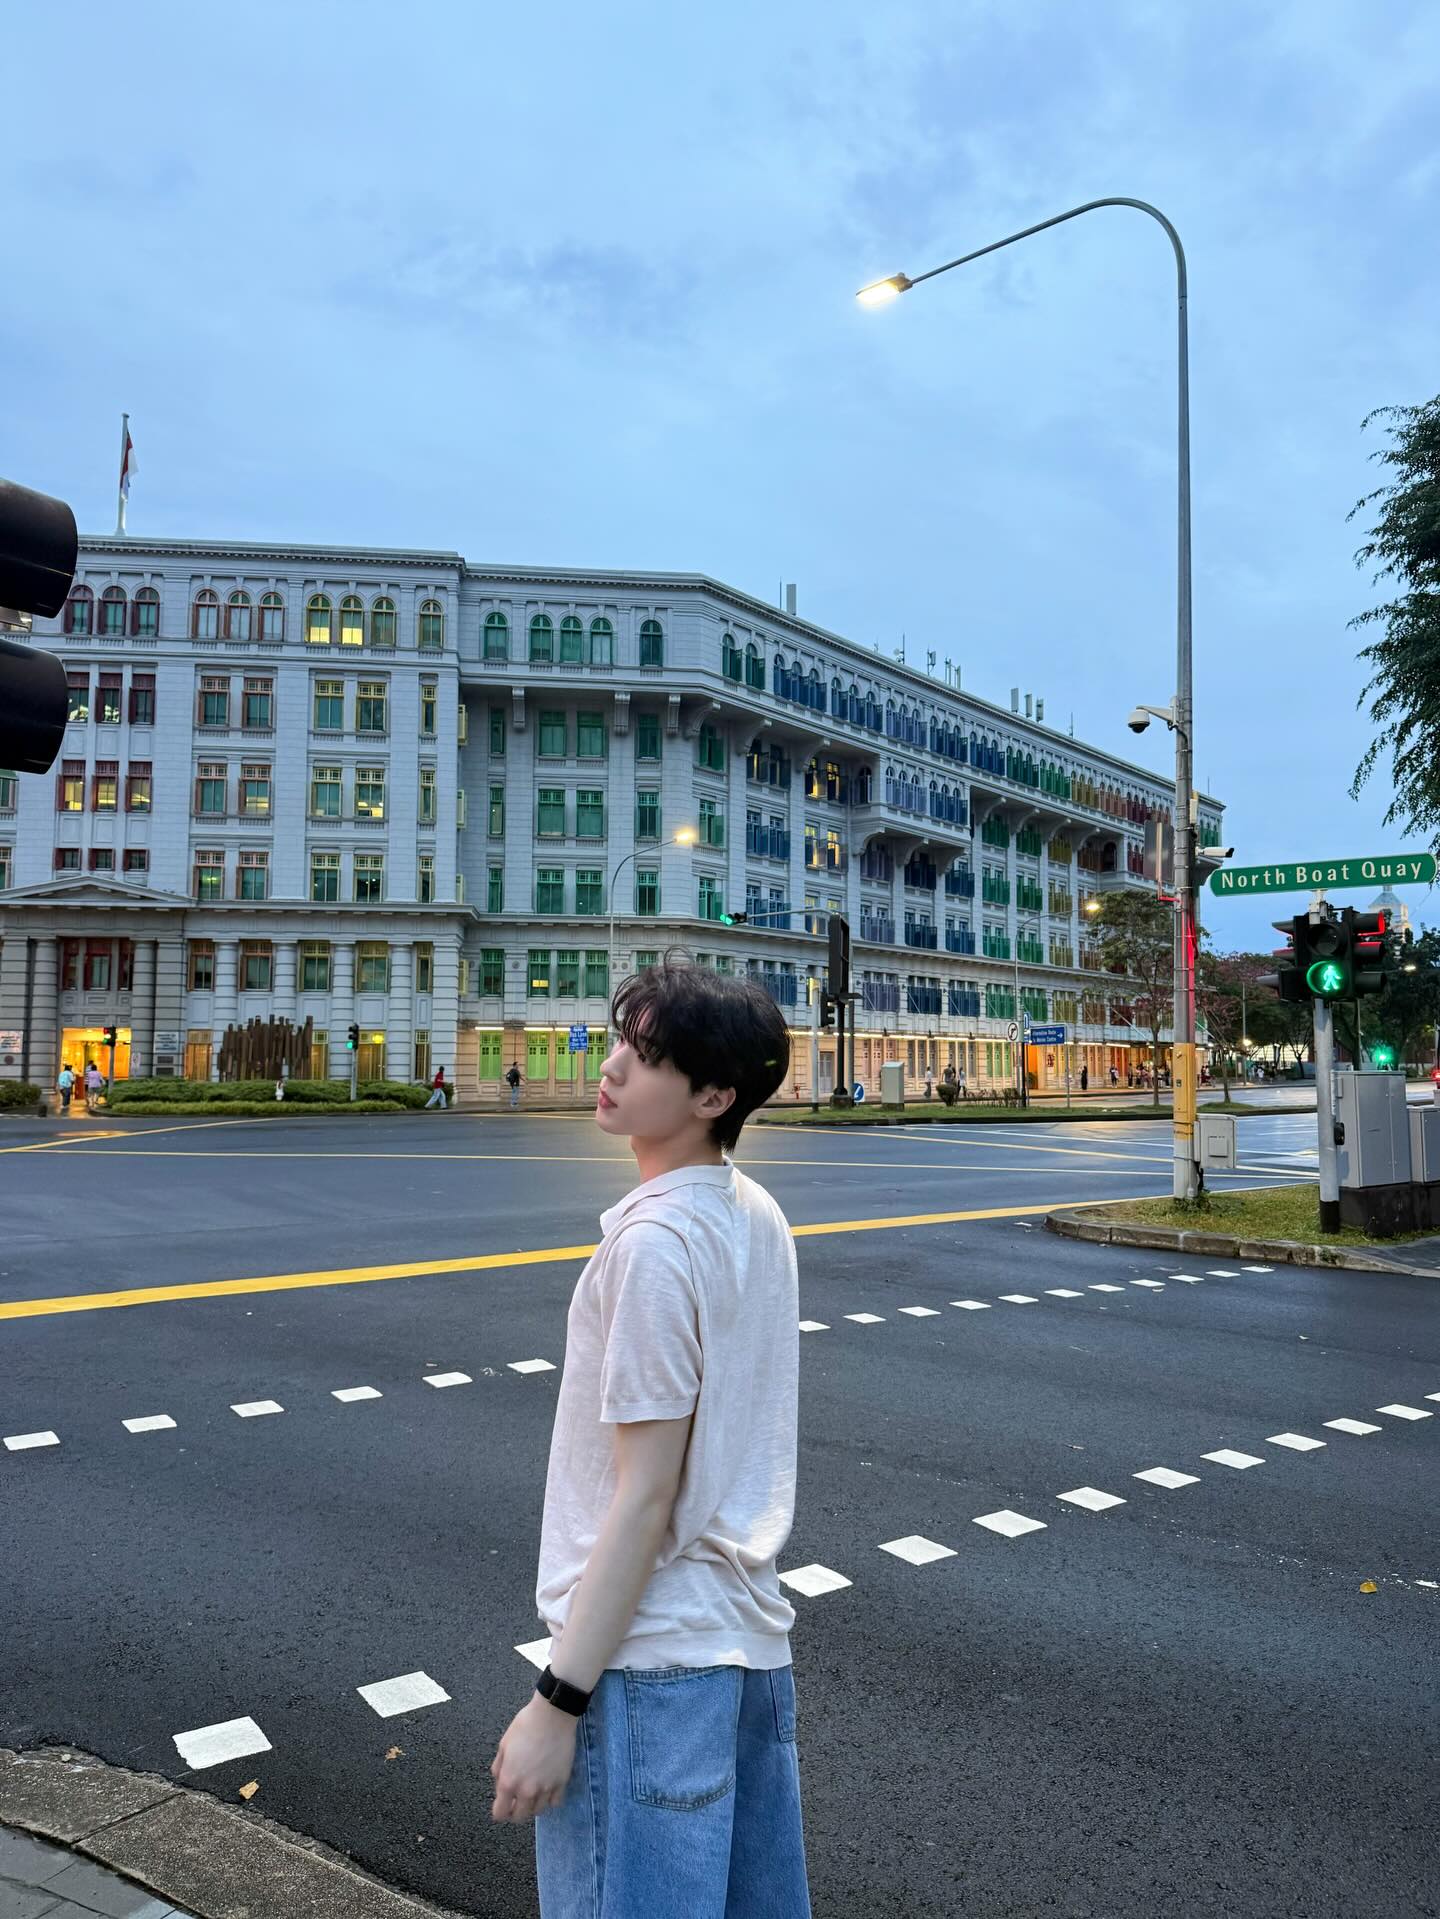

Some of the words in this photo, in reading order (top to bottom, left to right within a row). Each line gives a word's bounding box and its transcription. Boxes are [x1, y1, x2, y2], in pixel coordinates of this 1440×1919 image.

[1221, 868, 1286, 890] North
[1295, 863, 1351, 884] Boat
[1360, 860, 1423, 880] Quay
